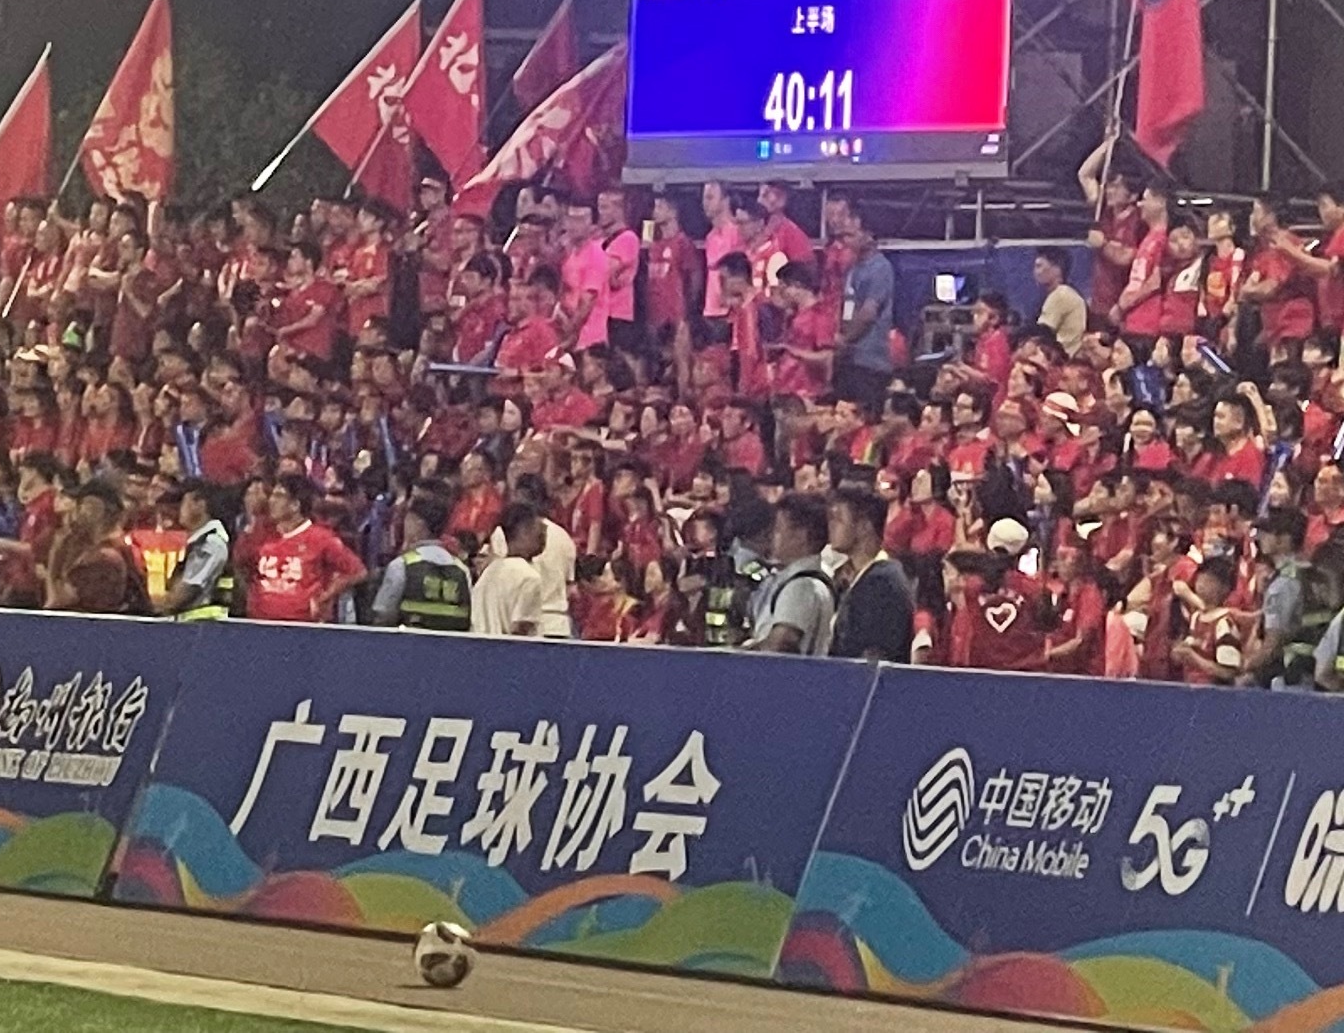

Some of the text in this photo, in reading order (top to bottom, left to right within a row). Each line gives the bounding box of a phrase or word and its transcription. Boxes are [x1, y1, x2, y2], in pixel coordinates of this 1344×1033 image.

[790, 5, 836, 35] 上半场
[763, 69, 854, 132] 40:11
[229, 698, 723, 882] 广西足球协会
[978, 767, 1114, 835] 中国移动
[960, 834, 1091, 880] China Mobile
